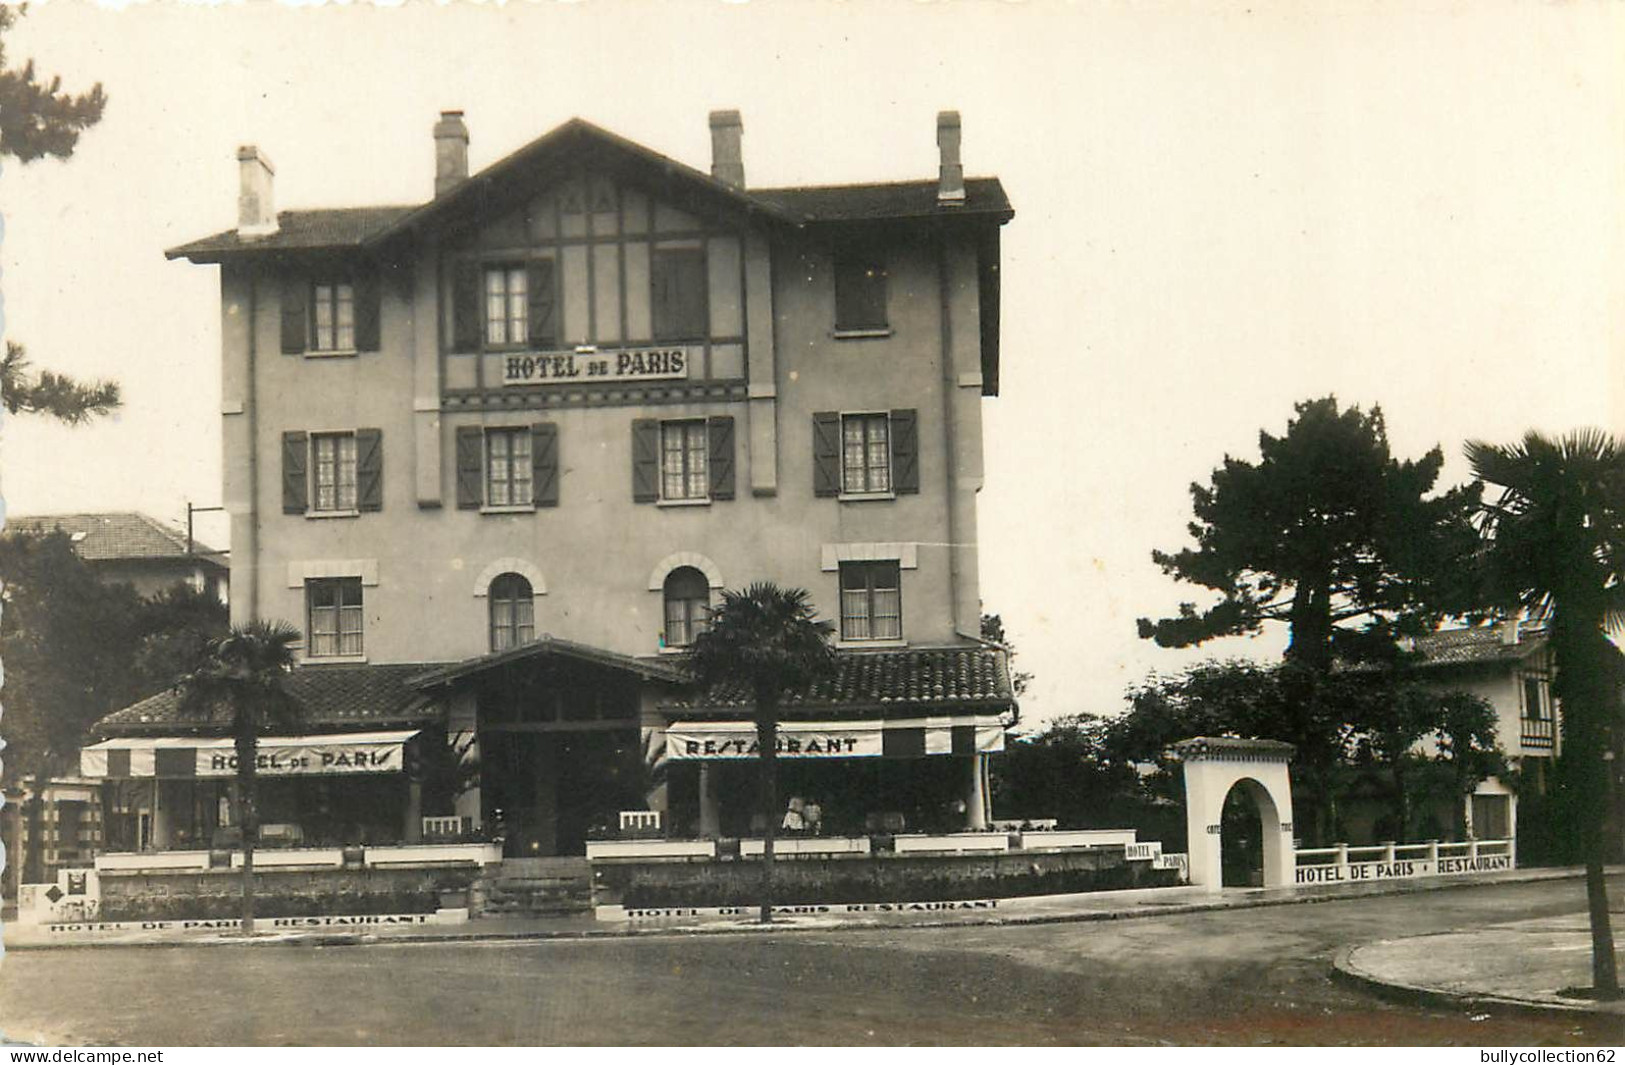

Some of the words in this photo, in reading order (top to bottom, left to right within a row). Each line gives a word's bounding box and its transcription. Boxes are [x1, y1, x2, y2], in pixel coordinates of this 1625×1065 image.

[506, 356, 579, 379] HOTEL
[587, 361, 609, 376] DE
[615, 351, 684, 375] PARIS
[212, 754, 281, 770] HOEL
[1295, 867, 1344, 883] HOTEL
[1351, 864, 1369, 879] DE
[1377, 861, 1414, 878] PARIS
[1437, 856, 1510, 873] RESTAURANT
[51, 923, 130, 932] HOTEL
[184, 920, 244, 929] PARI
[274, 915, 426, 927] RESTAURANT
